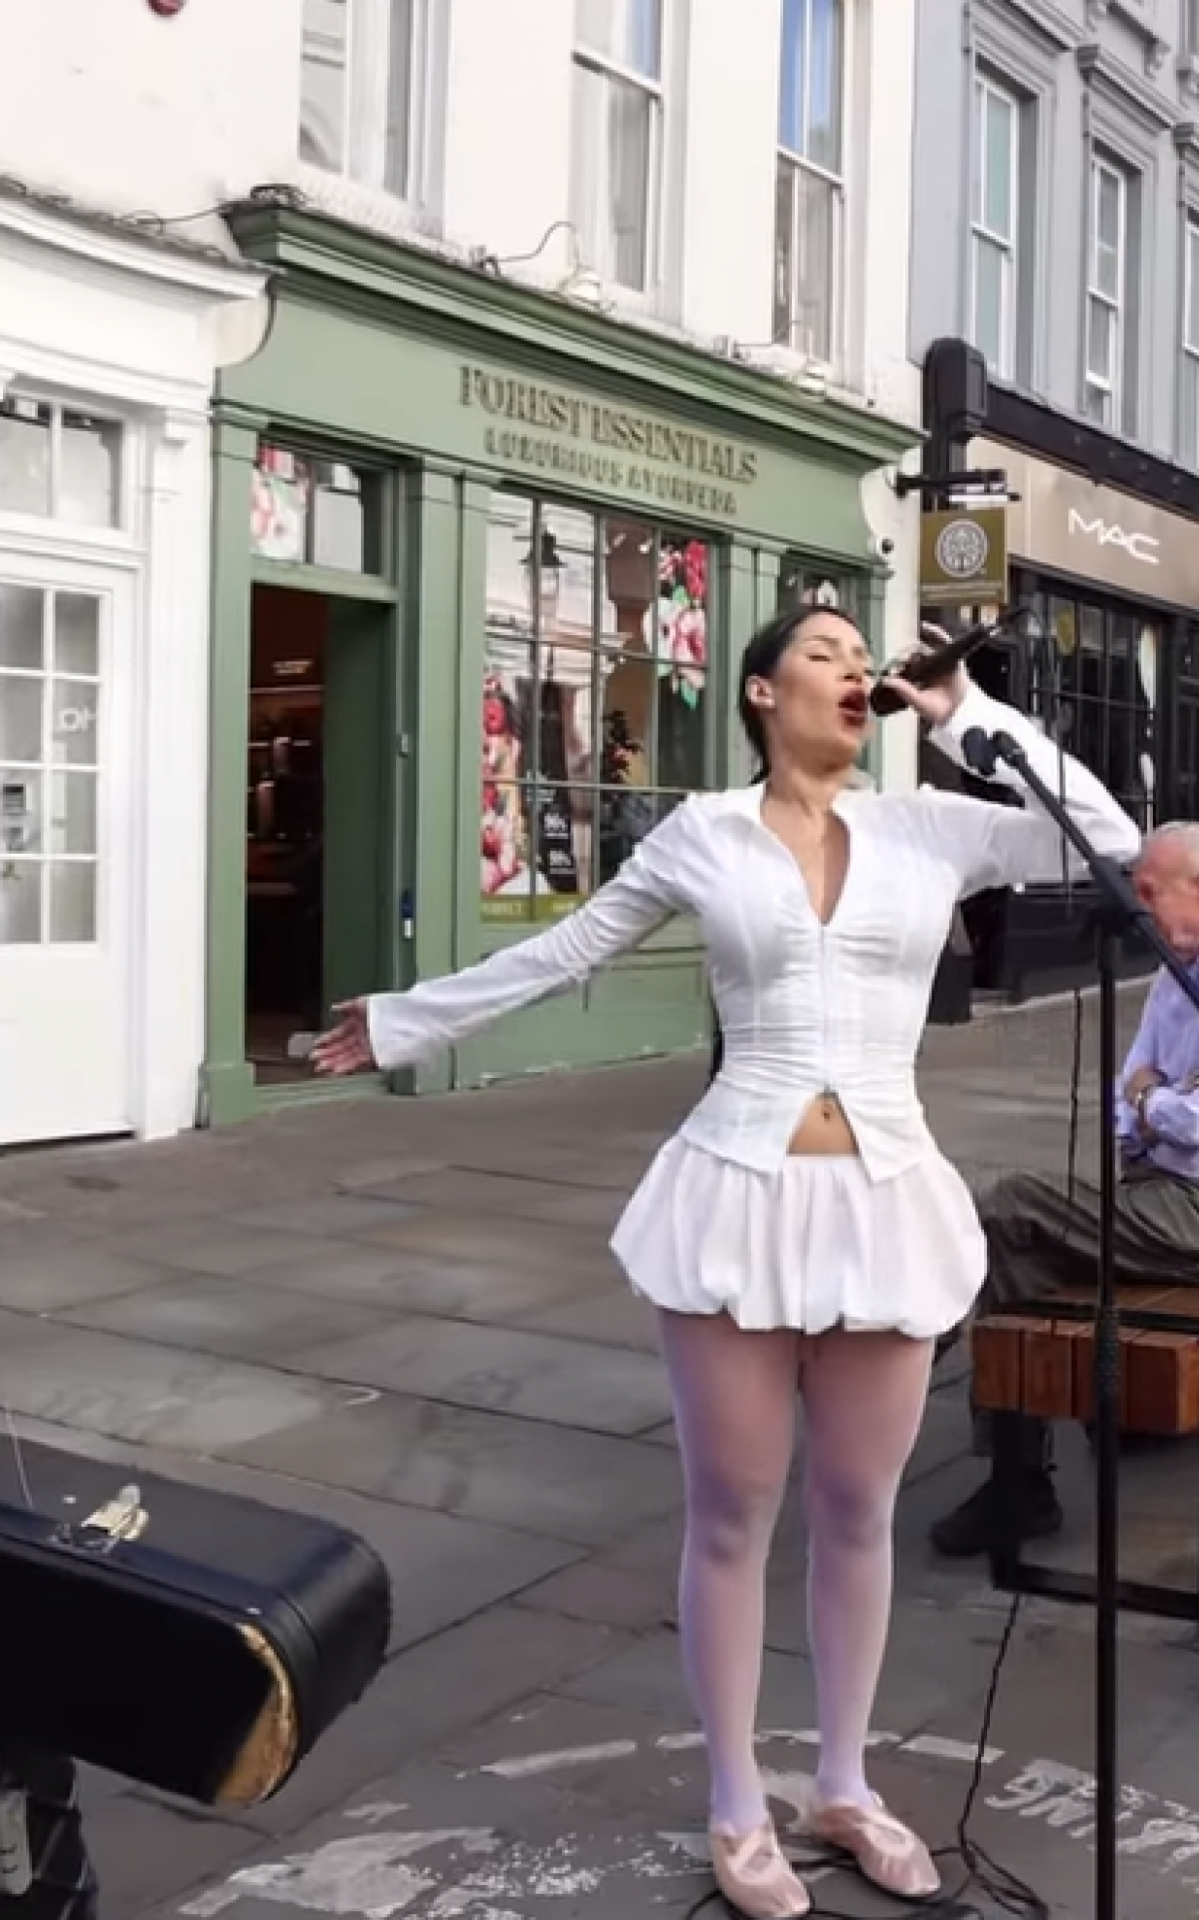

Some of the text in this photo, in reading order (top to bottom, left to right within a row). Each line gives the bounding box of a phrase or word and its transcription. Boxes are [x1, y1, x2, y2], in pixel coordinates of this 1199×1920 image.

[460, 365, 758, 484] FOREST ESSENTIALS
[1068, 507, 1160, 564] MAC
